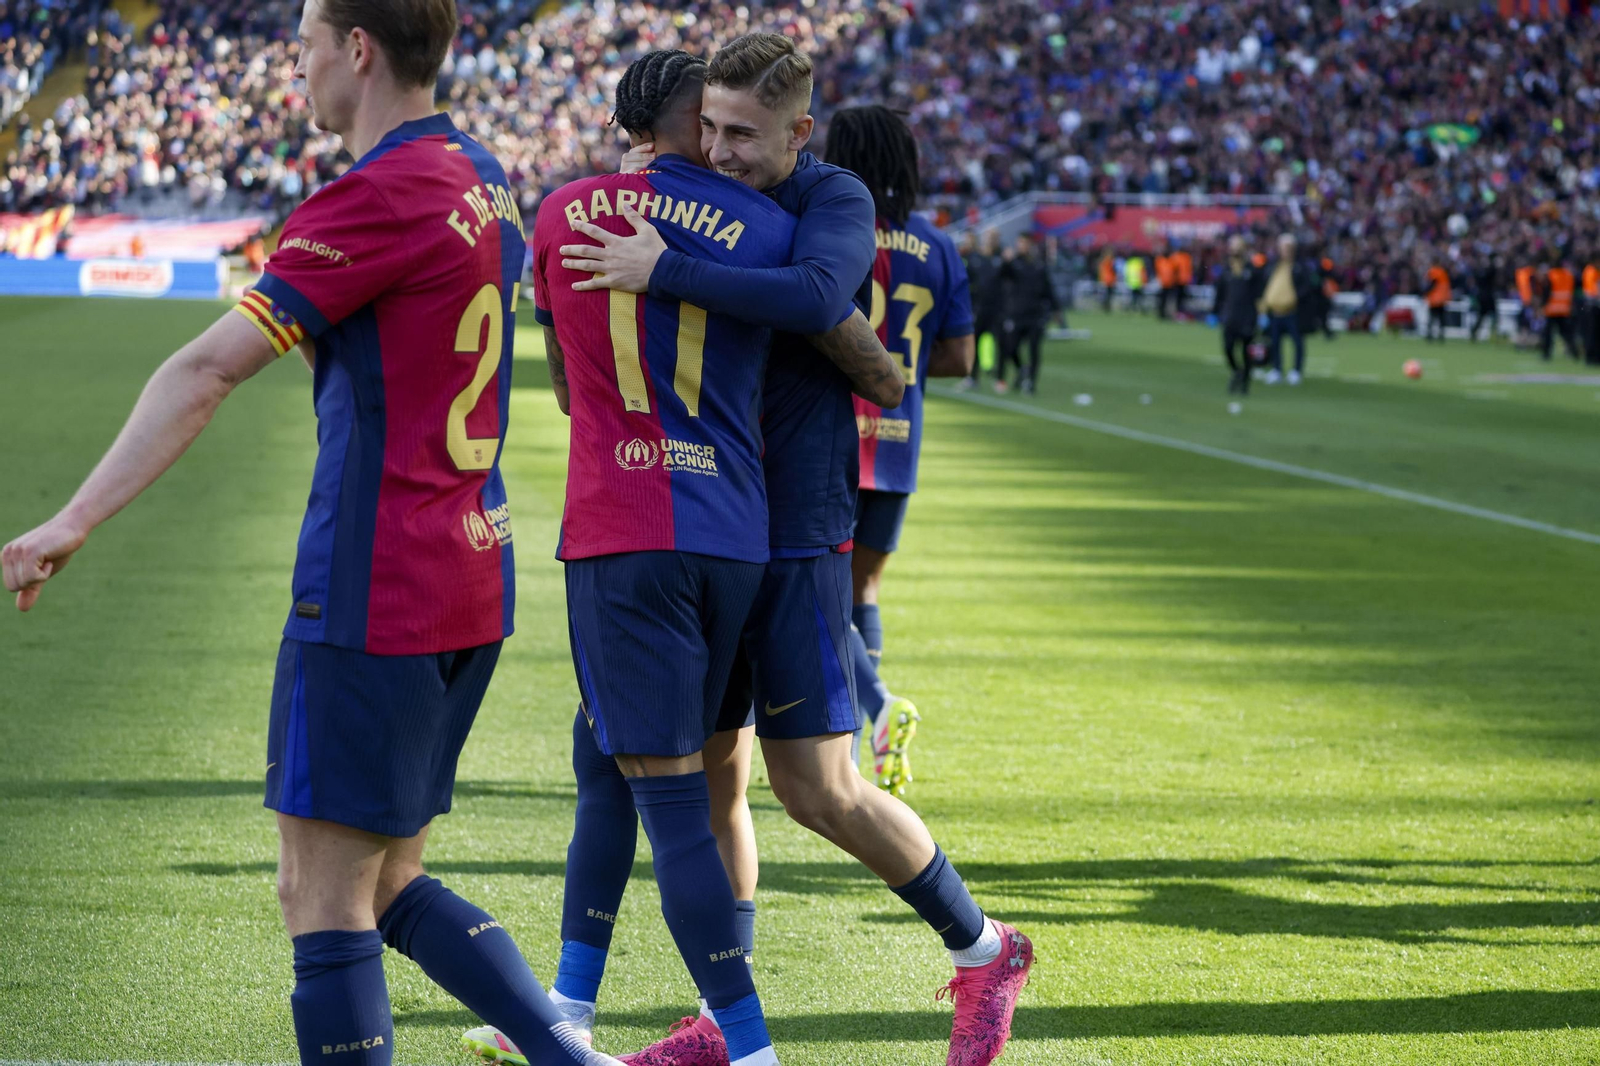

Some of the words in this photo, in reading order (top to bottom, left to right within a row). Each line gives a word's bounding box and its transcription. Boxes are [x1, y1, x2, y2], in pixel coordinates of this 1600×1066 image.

[485, 183, 526, 242] JON
[564, 188, 746, 251] RAPHINHA
[280, 237, 344, 261] AMBILIGHT
[592, 271, 708, 418] 11
[446, 282, 521, 471] 2
[660, 438, 716, 459] UNHCR
[662, 452, 718, 471] ACNUR
[684, 466, 701, 474] Refugee
[483, 503, 510, 525] UNHC
